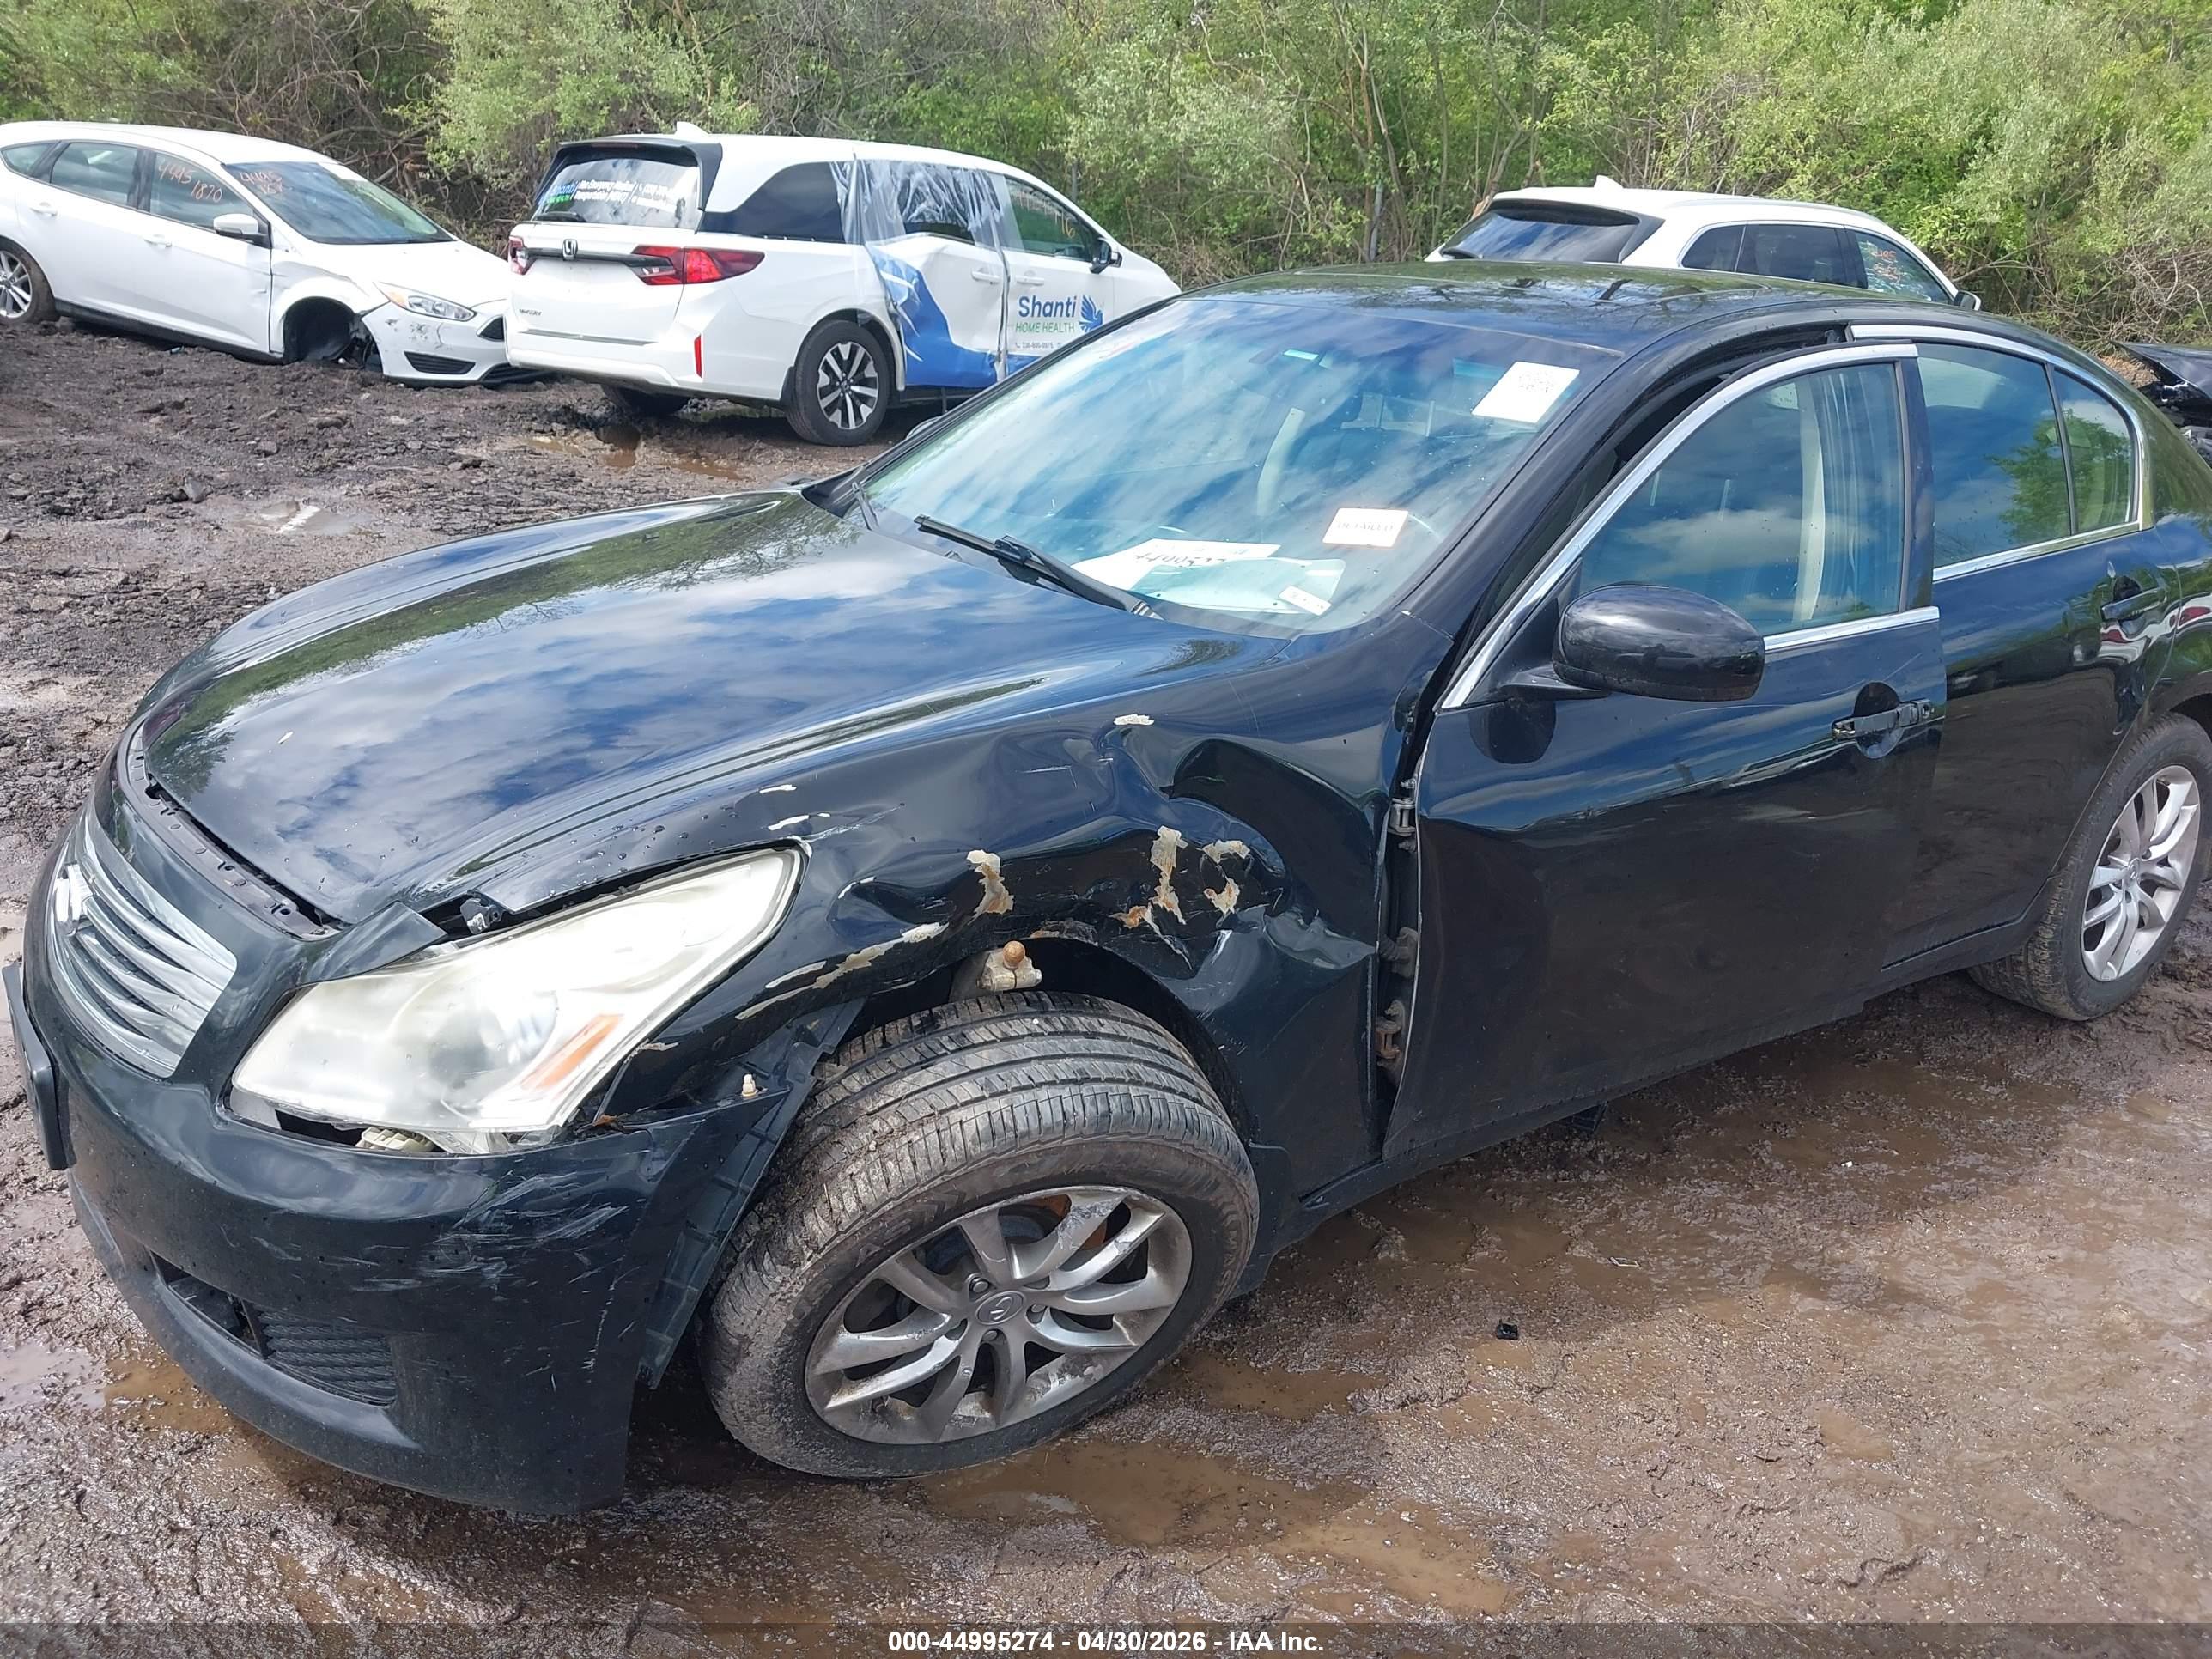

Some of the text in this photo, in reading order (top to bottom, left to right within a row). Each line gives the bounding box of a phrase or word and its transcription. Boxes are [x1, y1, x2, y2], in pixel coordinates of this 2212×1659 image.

[1018, 295, 1078, 318] Shanti
[1016, 321, 1076, 333] HOME HEALTH
